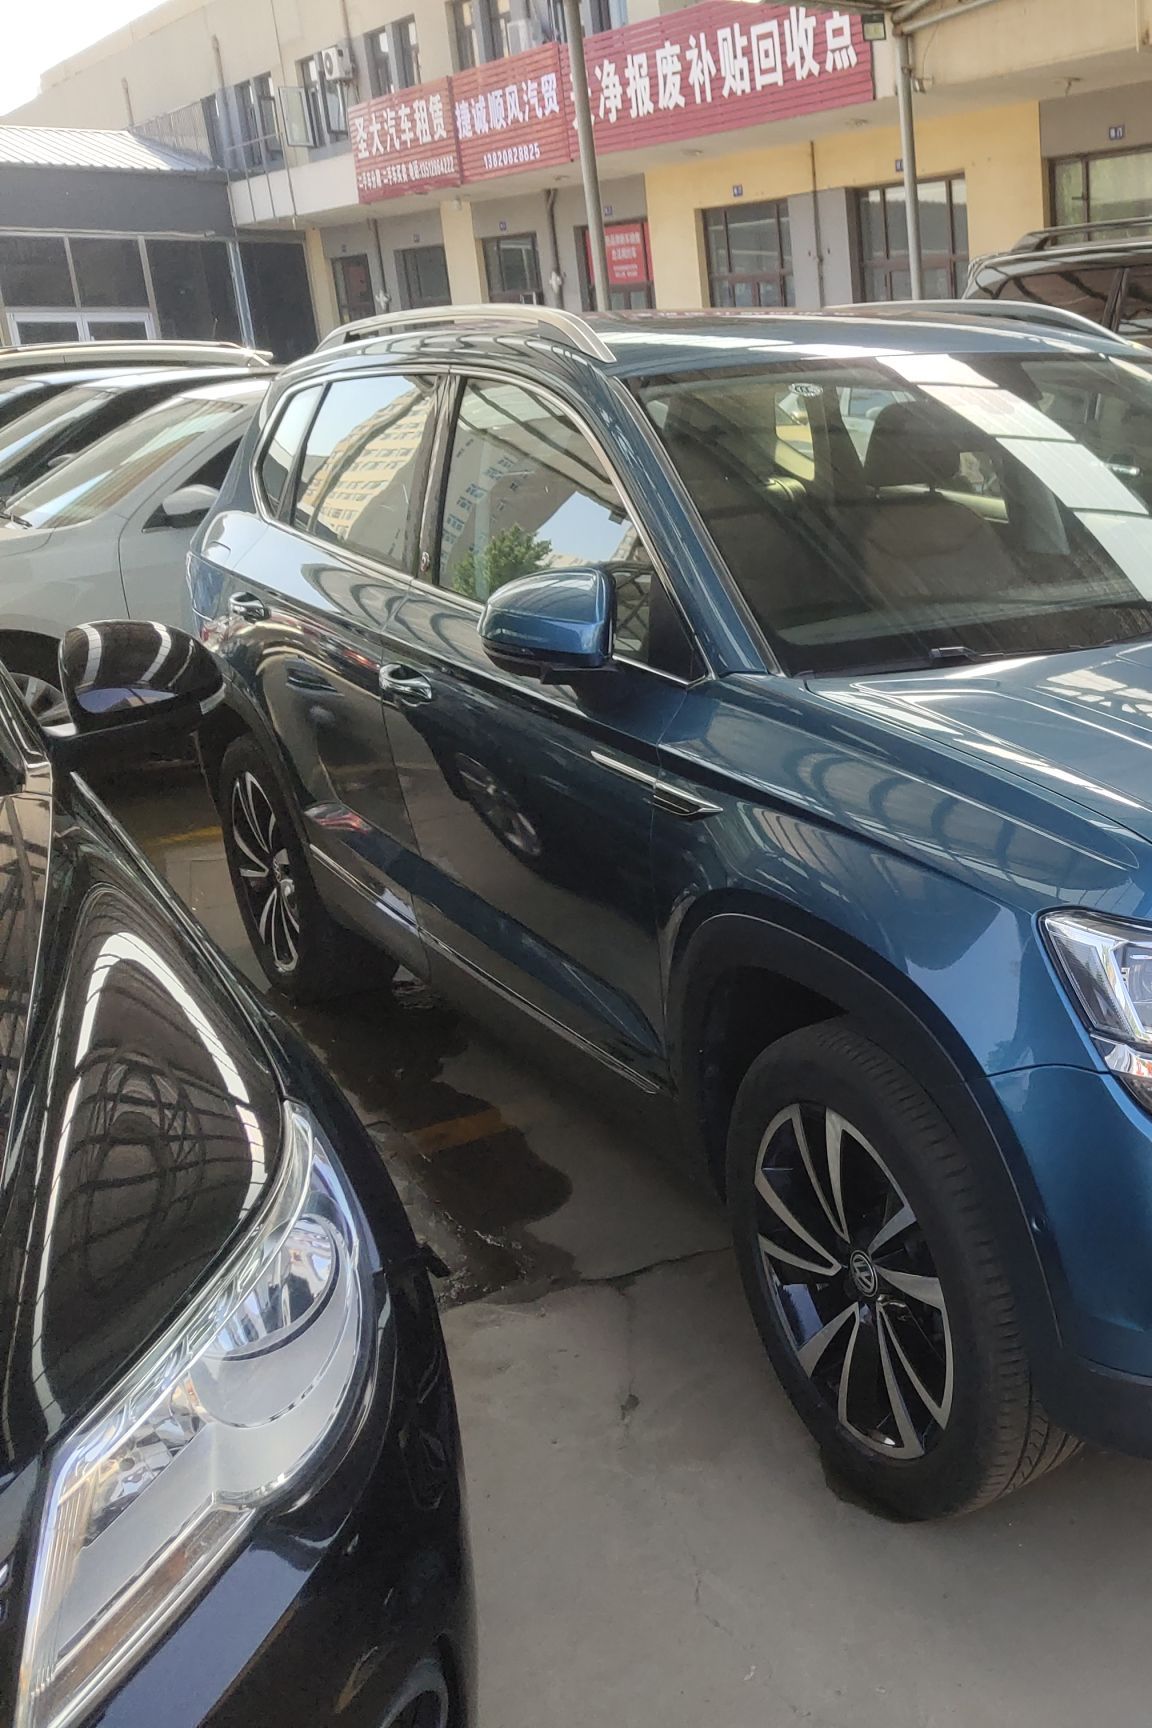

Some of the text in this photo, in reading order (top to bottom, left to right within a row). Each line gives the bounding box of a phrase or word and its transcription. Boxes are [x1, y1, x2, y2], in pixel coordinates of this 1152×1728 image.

[355, 94, 448, 159] 圣大汽车租赁
[454, 72, 560, 140] 捷诚顺风汽贸
[482, 142, 541, 170] 13820828825
